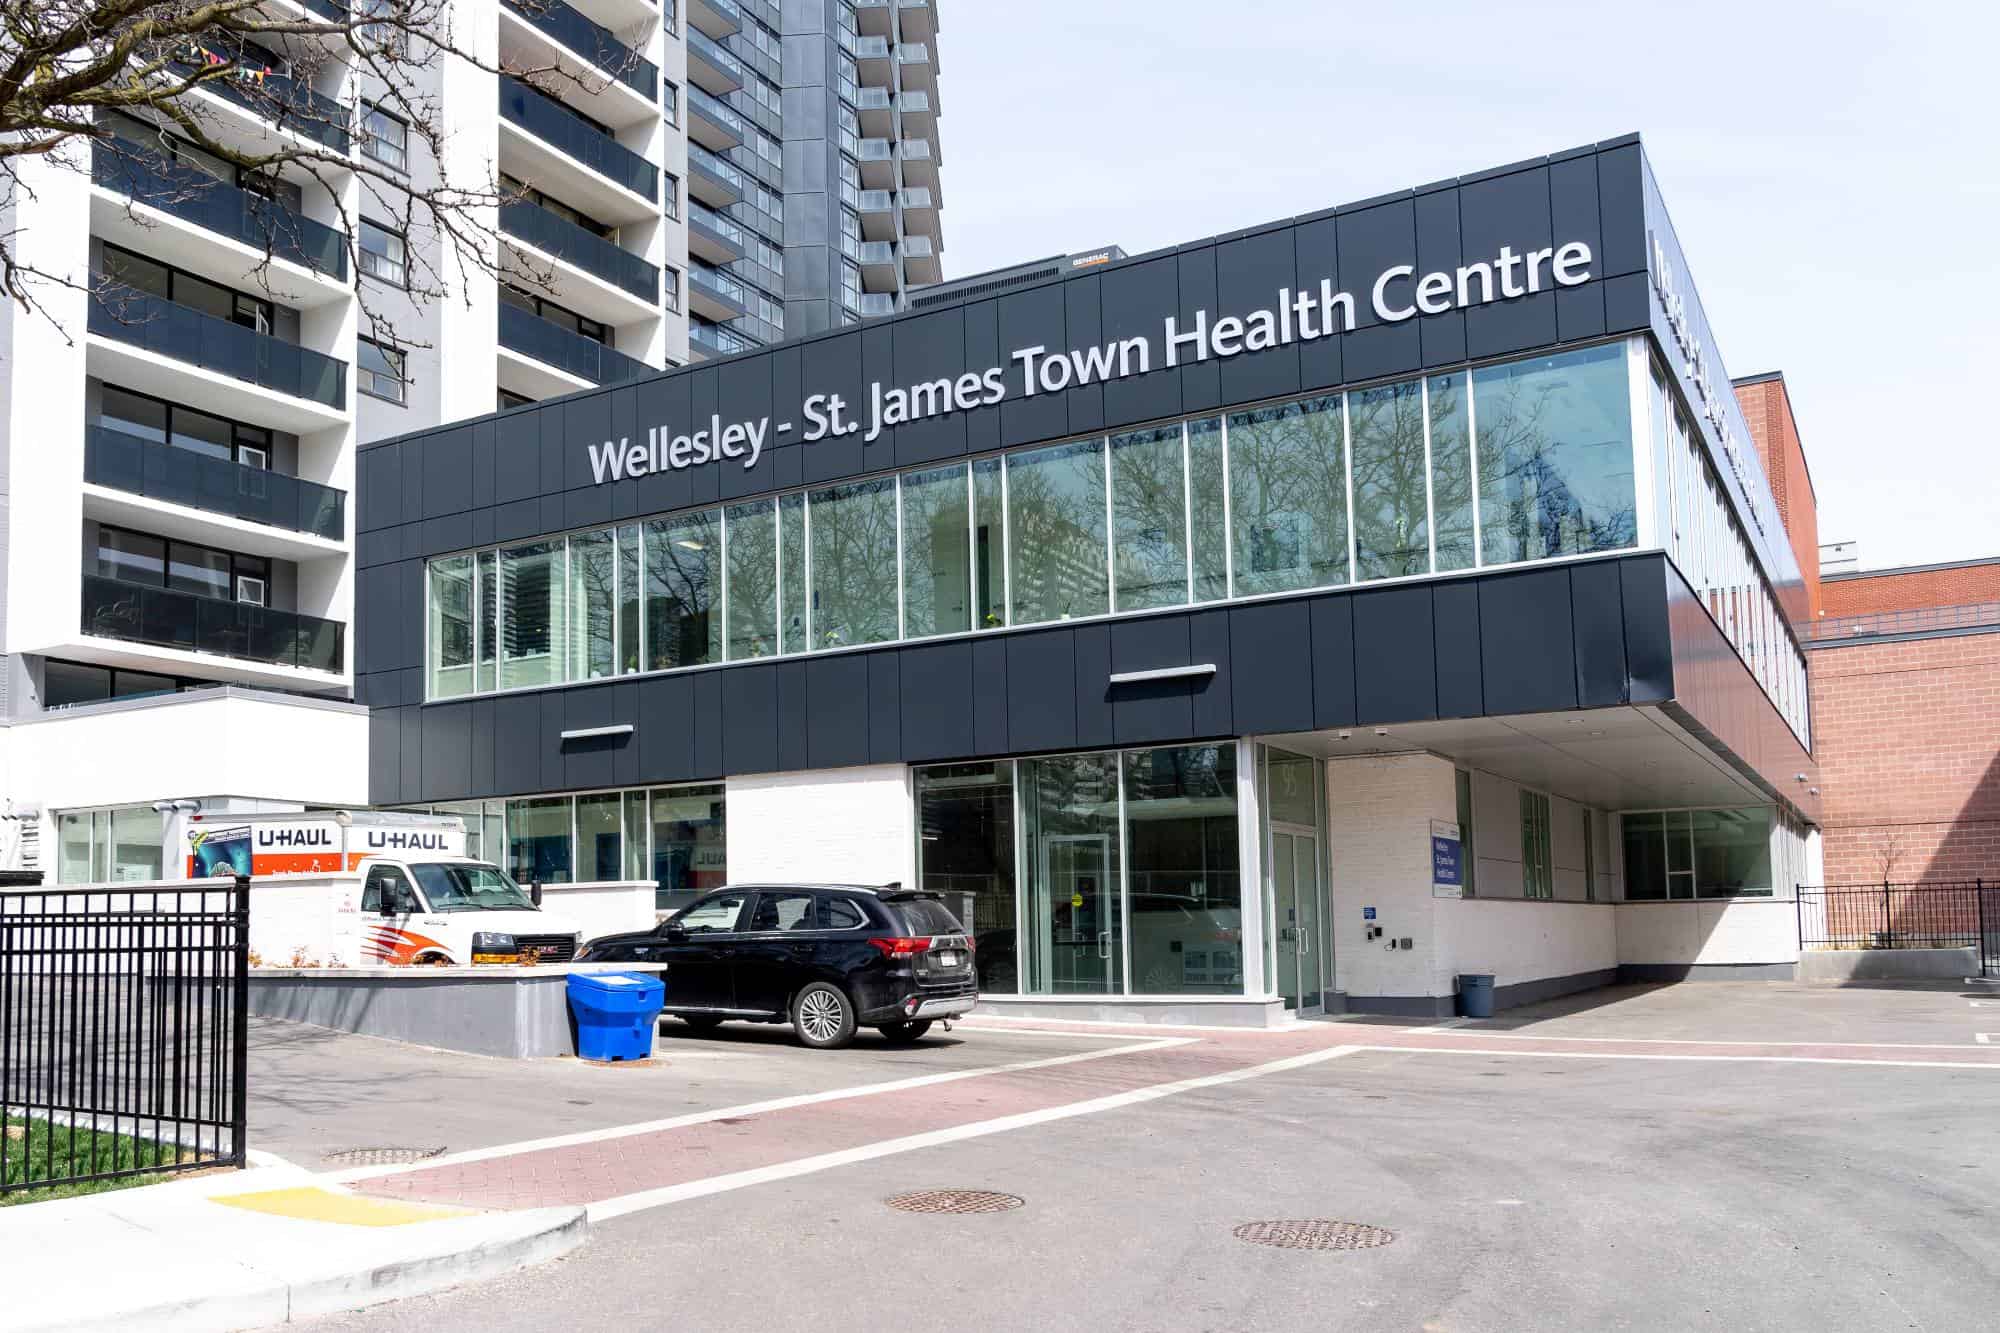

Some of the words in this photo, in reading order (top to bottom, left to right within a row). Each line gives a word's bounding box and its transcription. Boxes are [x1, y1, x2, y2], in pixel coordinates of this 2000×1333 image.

[587, 414, 769, 485] Wellesley
[777, 422, 792, 432] -
[803, 393, 859, 441] St.
[864, 367, 1006, 442] James
[1012, 336, 1150, 396] Town
[1165, 278, 1356, 367] Health
[1372, 241, 1592, 321] Centre
